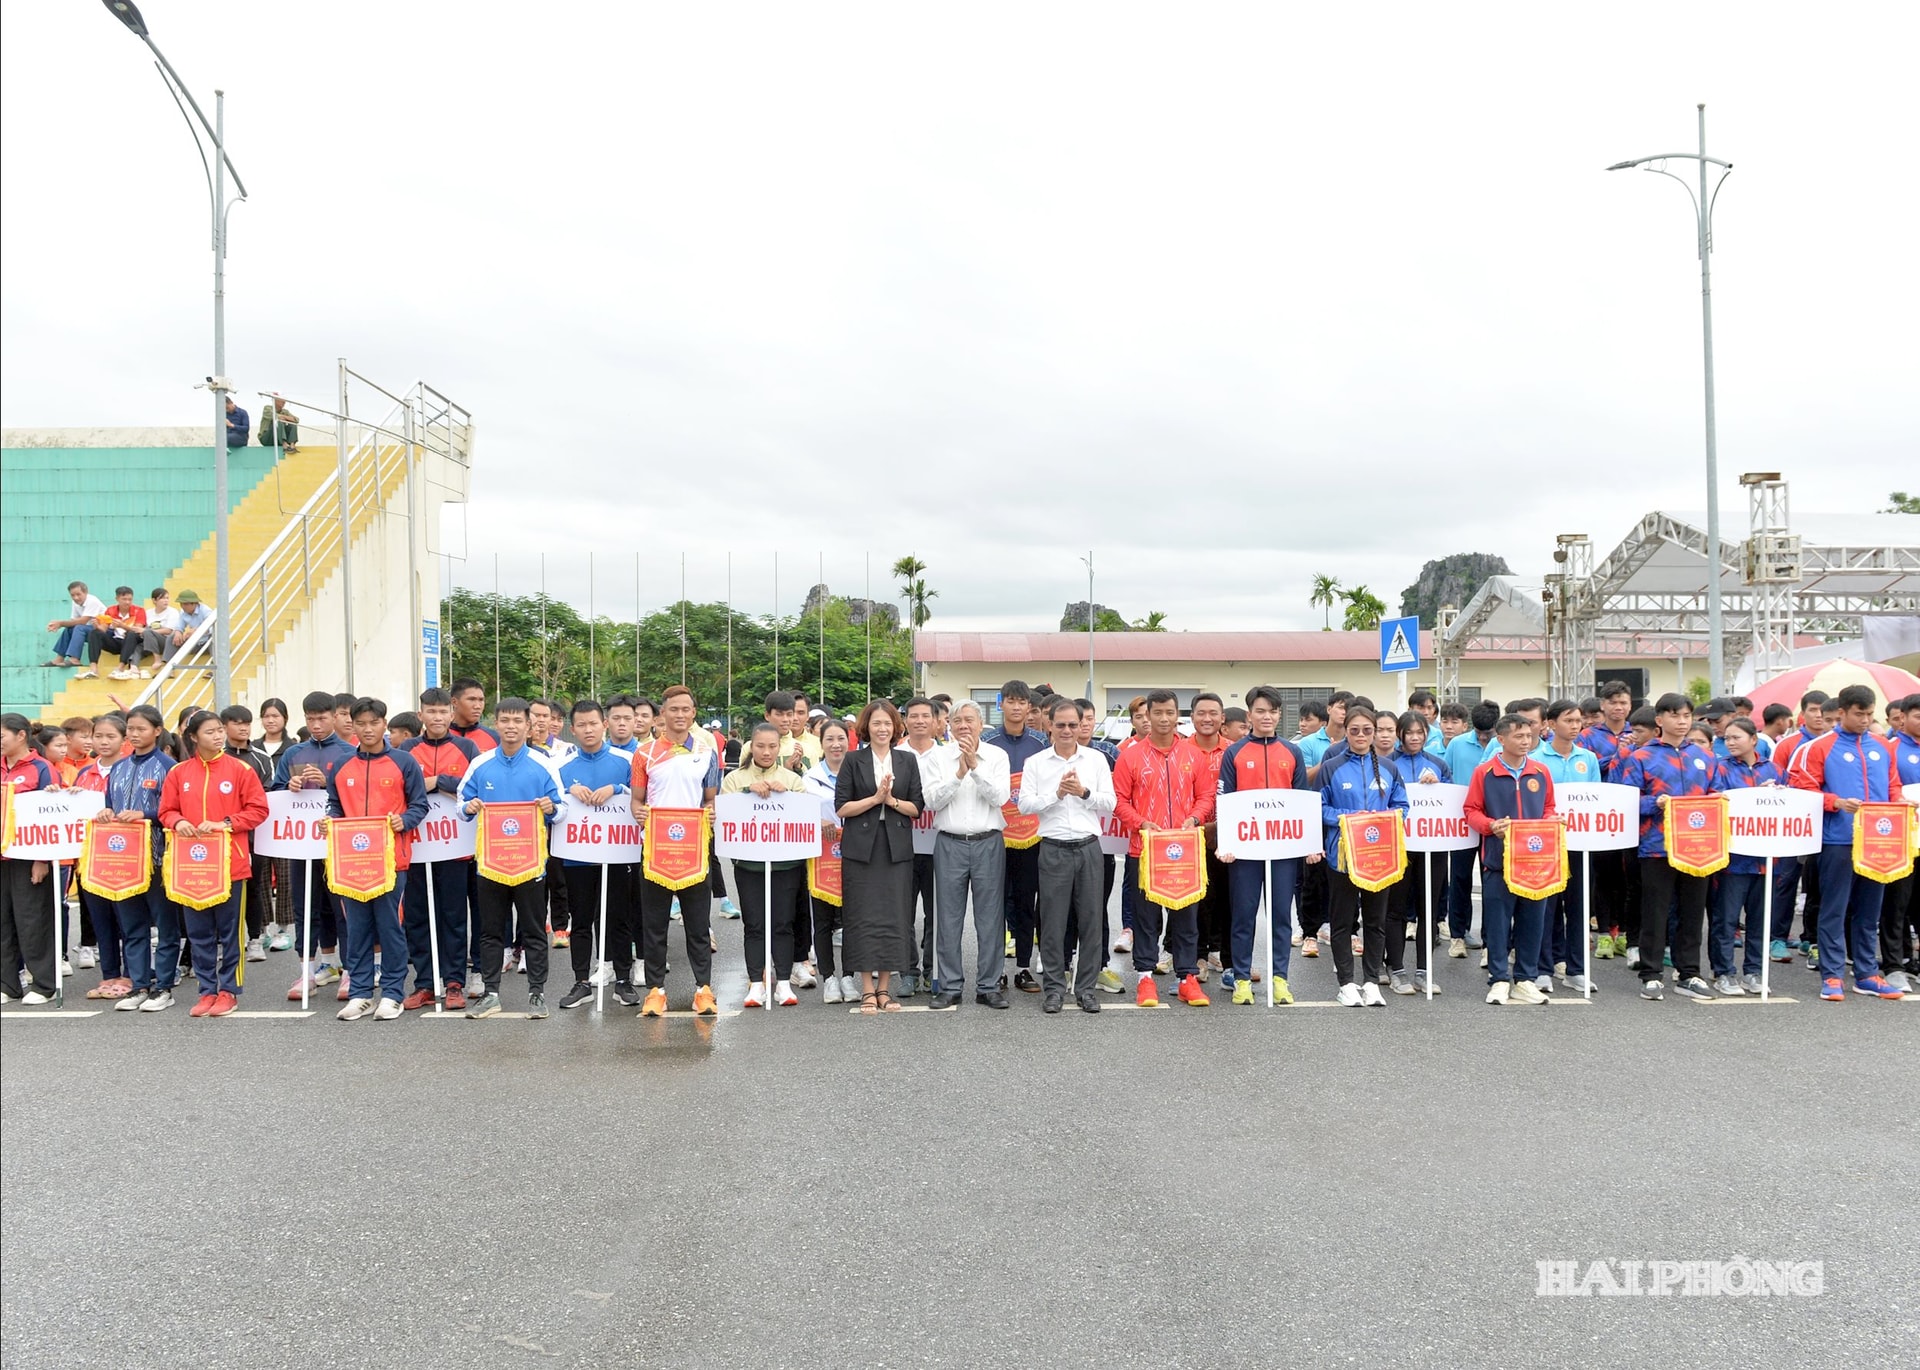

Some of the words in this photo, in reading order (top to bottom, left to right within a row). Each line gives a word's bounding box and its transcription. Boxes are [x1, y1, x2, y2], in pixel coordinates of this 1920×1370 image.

[292, 800, 324, 809] ĐOÀN
[753, 801, 785, 811] ĐOÀN
[1254, 799, 1285, 809] ĐOÀN
[1412, 797, 1444, 807] ĐOÀN
[1568, 791, 1599, 802] ĐOÀN
[1756, 796, 1786, 806] ĐOÀN
[38, 803, 70, 814] ĐOÀN
[594, 803, 626, 813] ĐOÀN
[273, 815, 306, 841] LÀO
[426, 815, 459, 845] NỘI
[566, 816, 602, 844] BẮC
[607, 824, 643, 845] NIN
[722, 822, 738, 842] TP.
[741, 815, 757, 842] HỒ
[761, 818, 780, 843] CHÍ
[784, 822, 815, 843] MINH
[1237, 816, 1260, 842] CÀ
[1265, 819, 1304, 840] MAU
[1417, 818, 1469, 838] GIANG
[1595, 809, 1624, 837] ĐỘI
[1728, 816, 1778, 837] THANH
[1782, 813, 1813, 837] HOÁ
[12, 823, 60, 847] HƯNG
